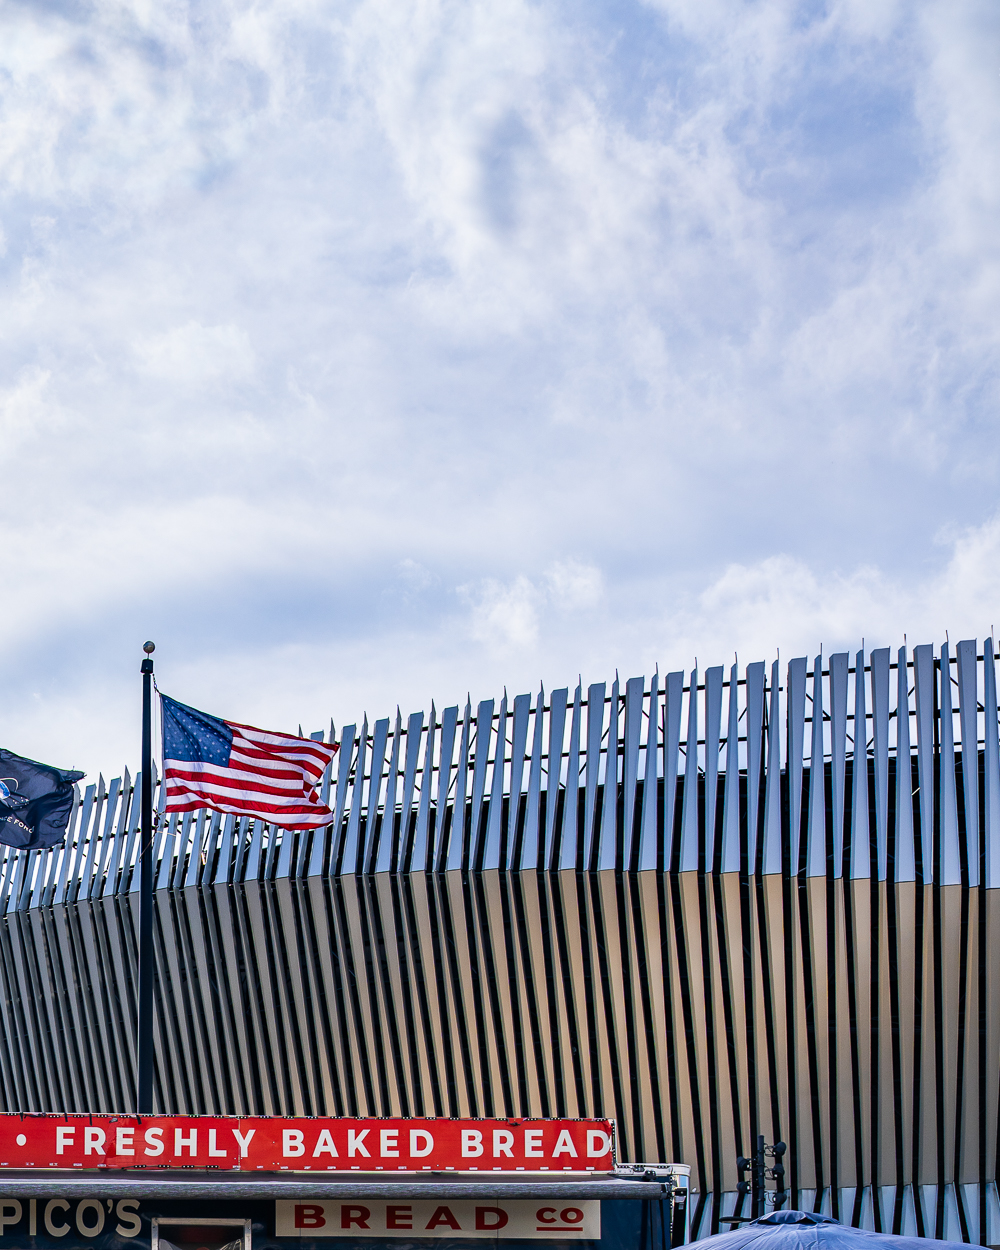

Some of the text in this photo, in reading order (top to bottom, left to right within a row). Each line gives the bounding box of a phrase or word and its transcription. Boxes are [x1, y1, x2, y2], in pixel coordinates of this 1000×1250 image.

[55, 1126, 258, 1157] FRESHLY
[282, 1128, 435, 1158] BAKED
[461, 1130, 613, 1159] BREAD
[294, 1204, 585, 1231] BREAD CO
